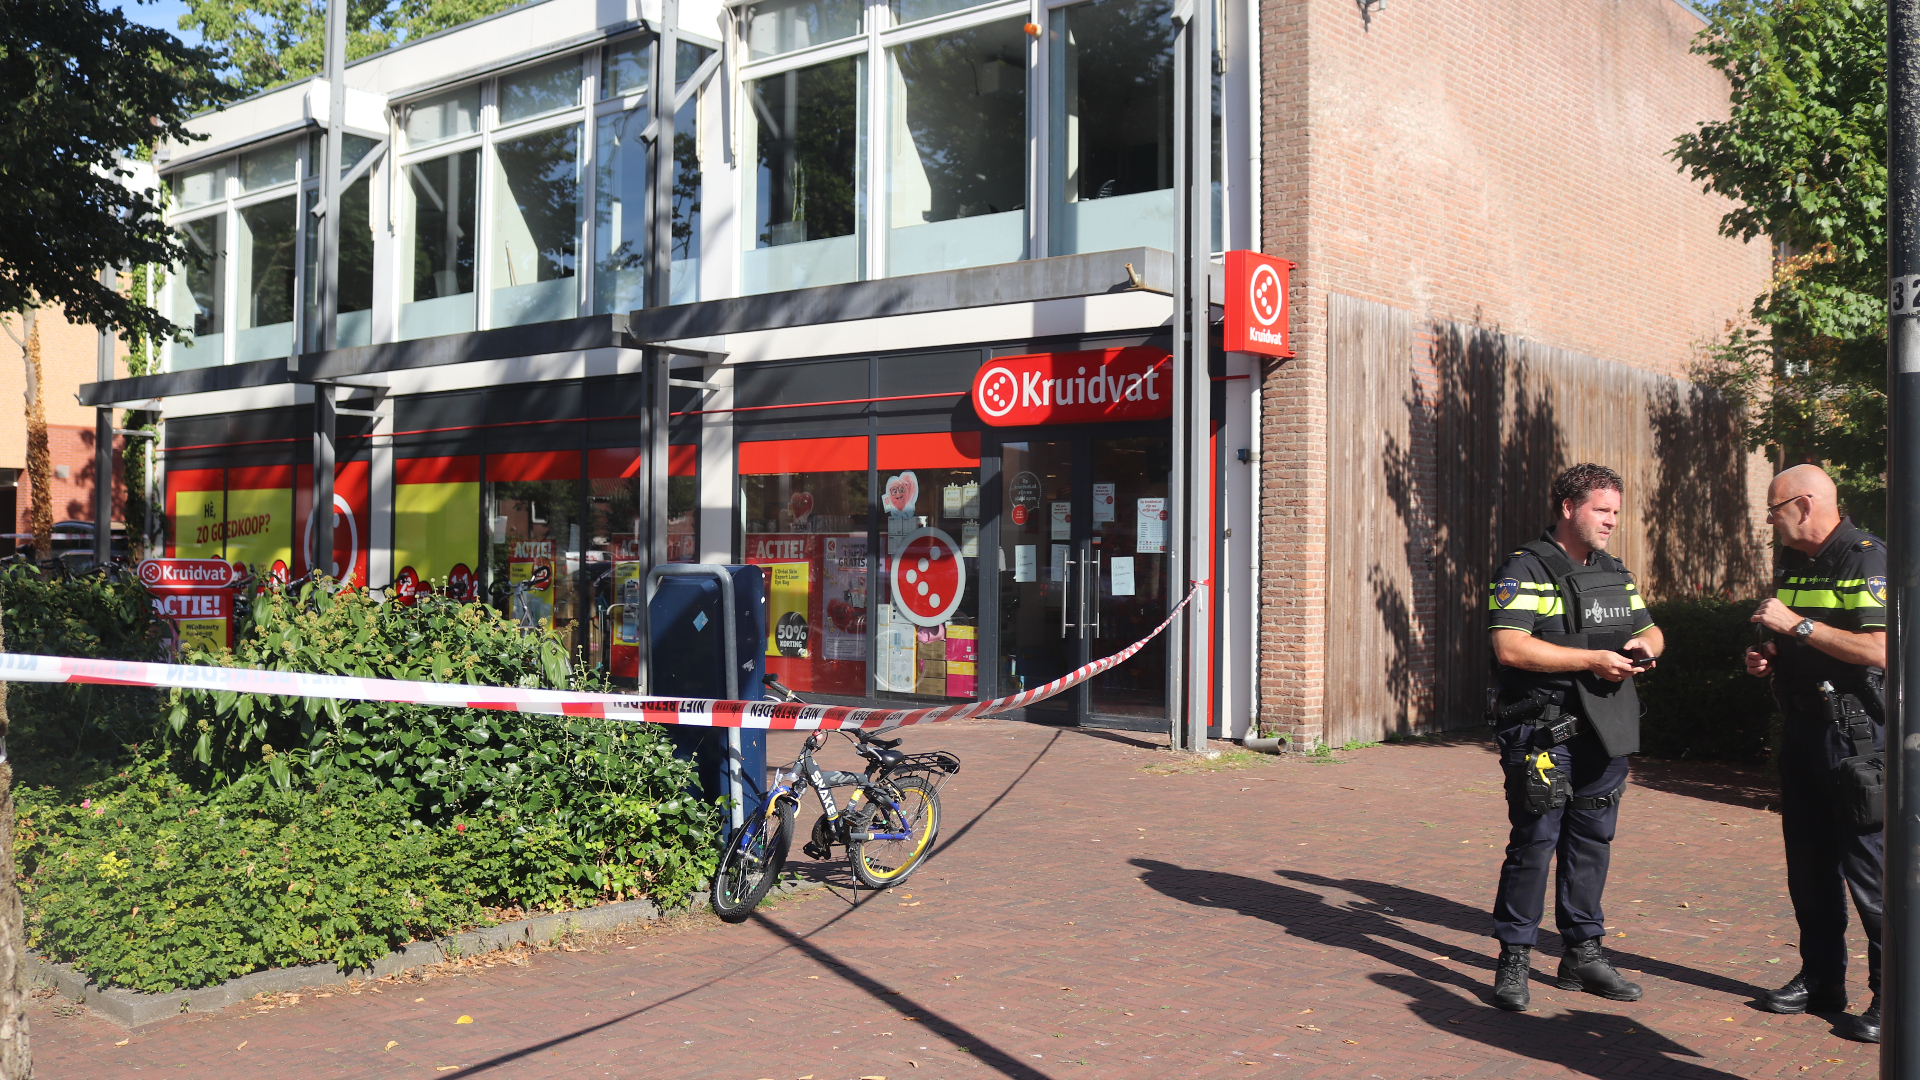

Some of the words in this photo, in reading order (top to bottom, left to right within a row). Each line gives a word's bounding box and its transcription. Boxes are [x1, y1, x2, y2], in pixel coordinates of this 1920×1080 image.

[1250, 326, 1282, 346] Kruidvat
[1022, 364, 1160, 408] Kruidvat
[196, 525, 209, 544] ZO
[211, 513, 271, 543] GOEDKOOP?
[514, 540, 552, 560] ACTIE!
[755, 539, 805, 560] ACTIE!
[162, 564, 227, 581] Kruidvat
[151, 594, 221, 616] ACTIE!
[1585, 603, 1632, 621] POLITIE
[777, 624, 807, 641] 50%
[779, 640, 803, 648] KORTING
[679, 700, 708, 714] NIET
[750, 703, 799, 720] BETREDEN
[799, 707, 822, 720] NIET
[810, 770, 836, 816] SNAKE
